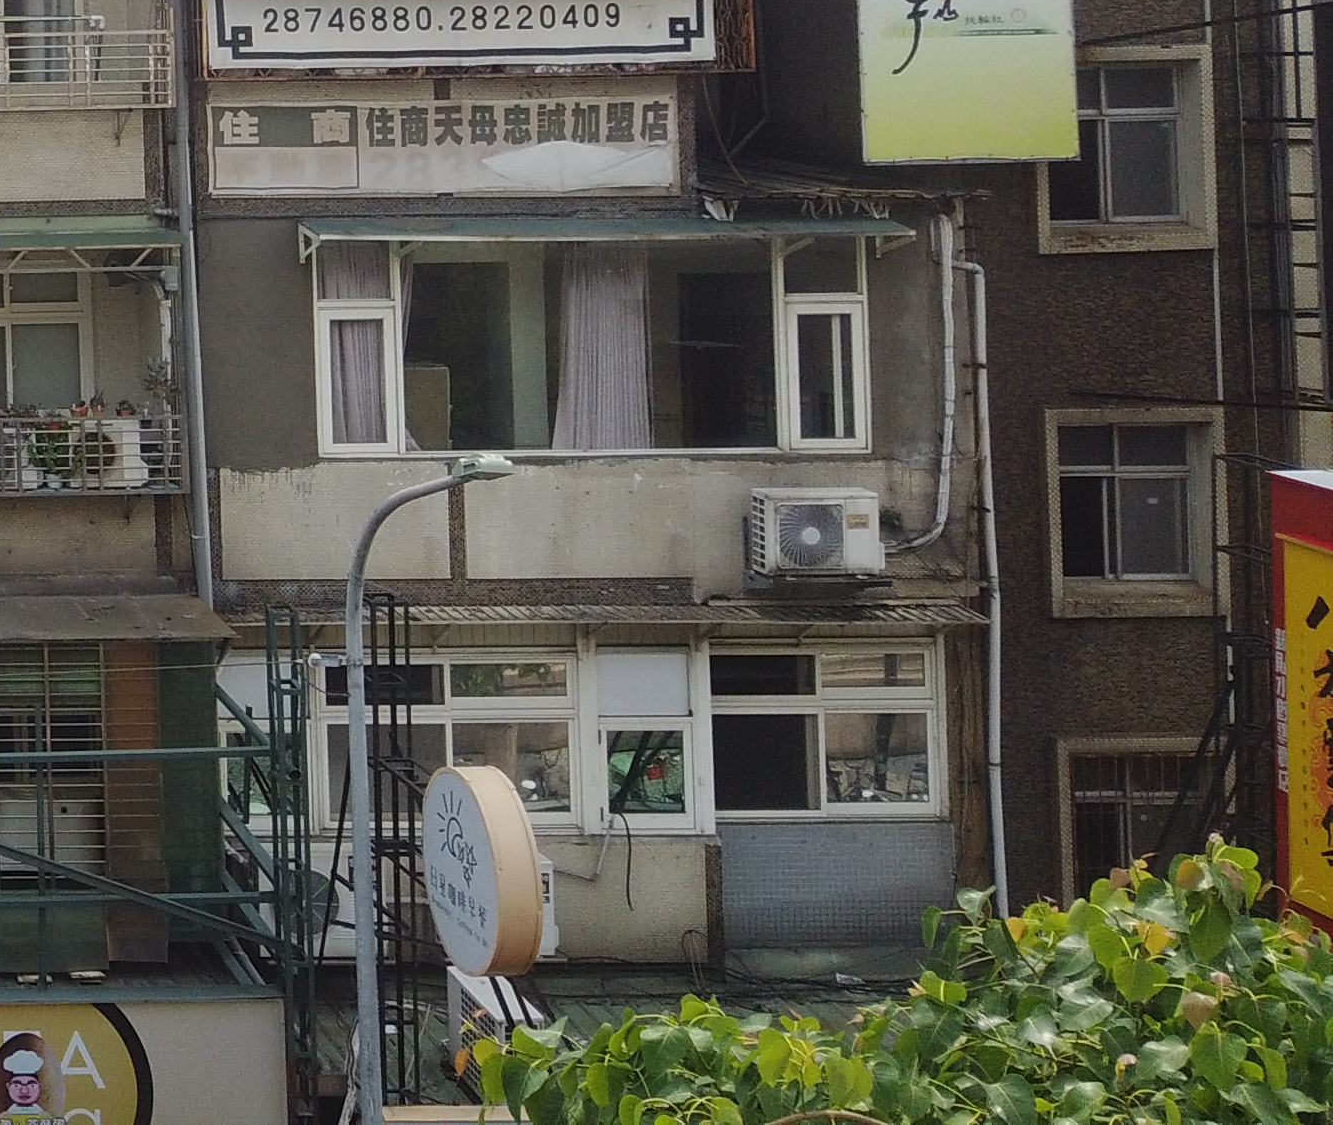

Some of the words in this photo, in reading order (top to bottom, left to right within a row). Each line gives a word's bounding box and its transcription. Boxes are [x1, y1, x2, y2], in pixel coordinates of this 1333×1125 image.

[366, 101, 669, 147] 住商天母忠誠加盟店
